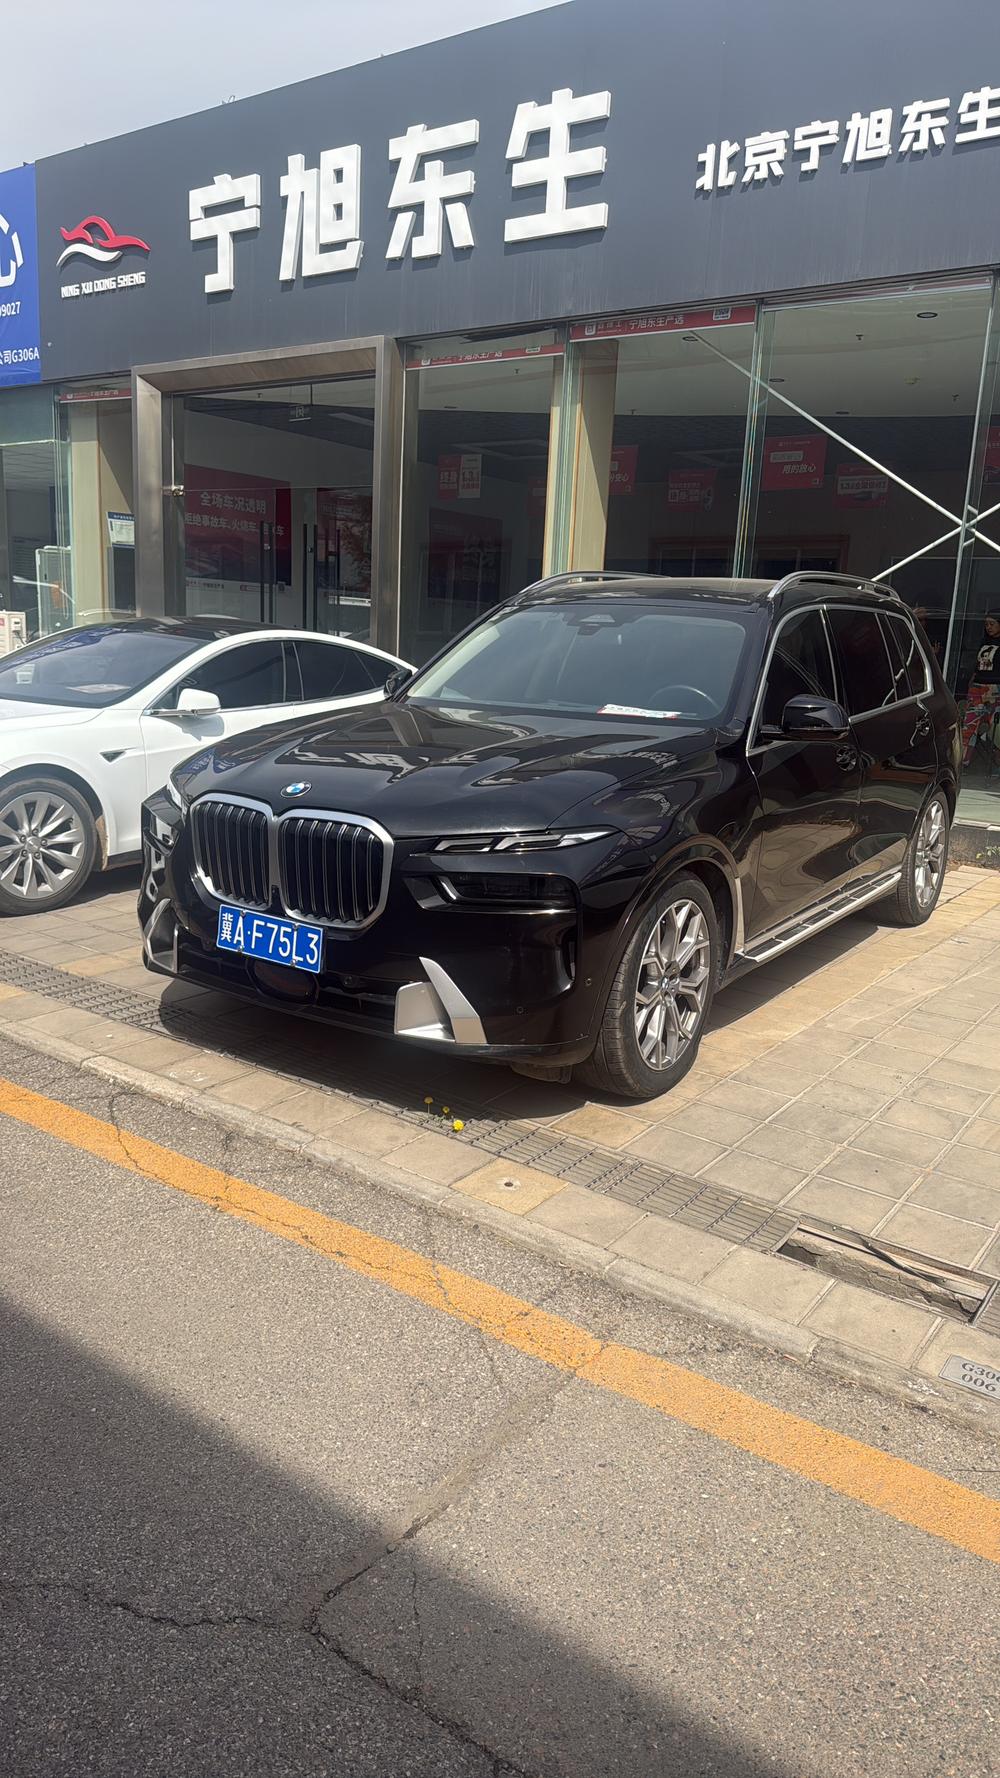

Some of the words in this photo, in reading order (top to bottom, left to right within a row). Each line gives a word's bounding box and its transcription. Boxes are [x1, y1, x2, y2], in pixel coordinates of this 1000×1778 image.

[695, 86, 1000, 192] 北京宁旭东生
[189, 88, 611, 294] 宁旭东生
[60, 284, 80, 298] NING
[94, 277, 116, 292] DONG
[117, 271, 146, 288] SHENG
[0, 301, 21, 318] 9027
[200, 491, 267, 514] 全场车况透明
[961, 1373, 996, 1392] 006
